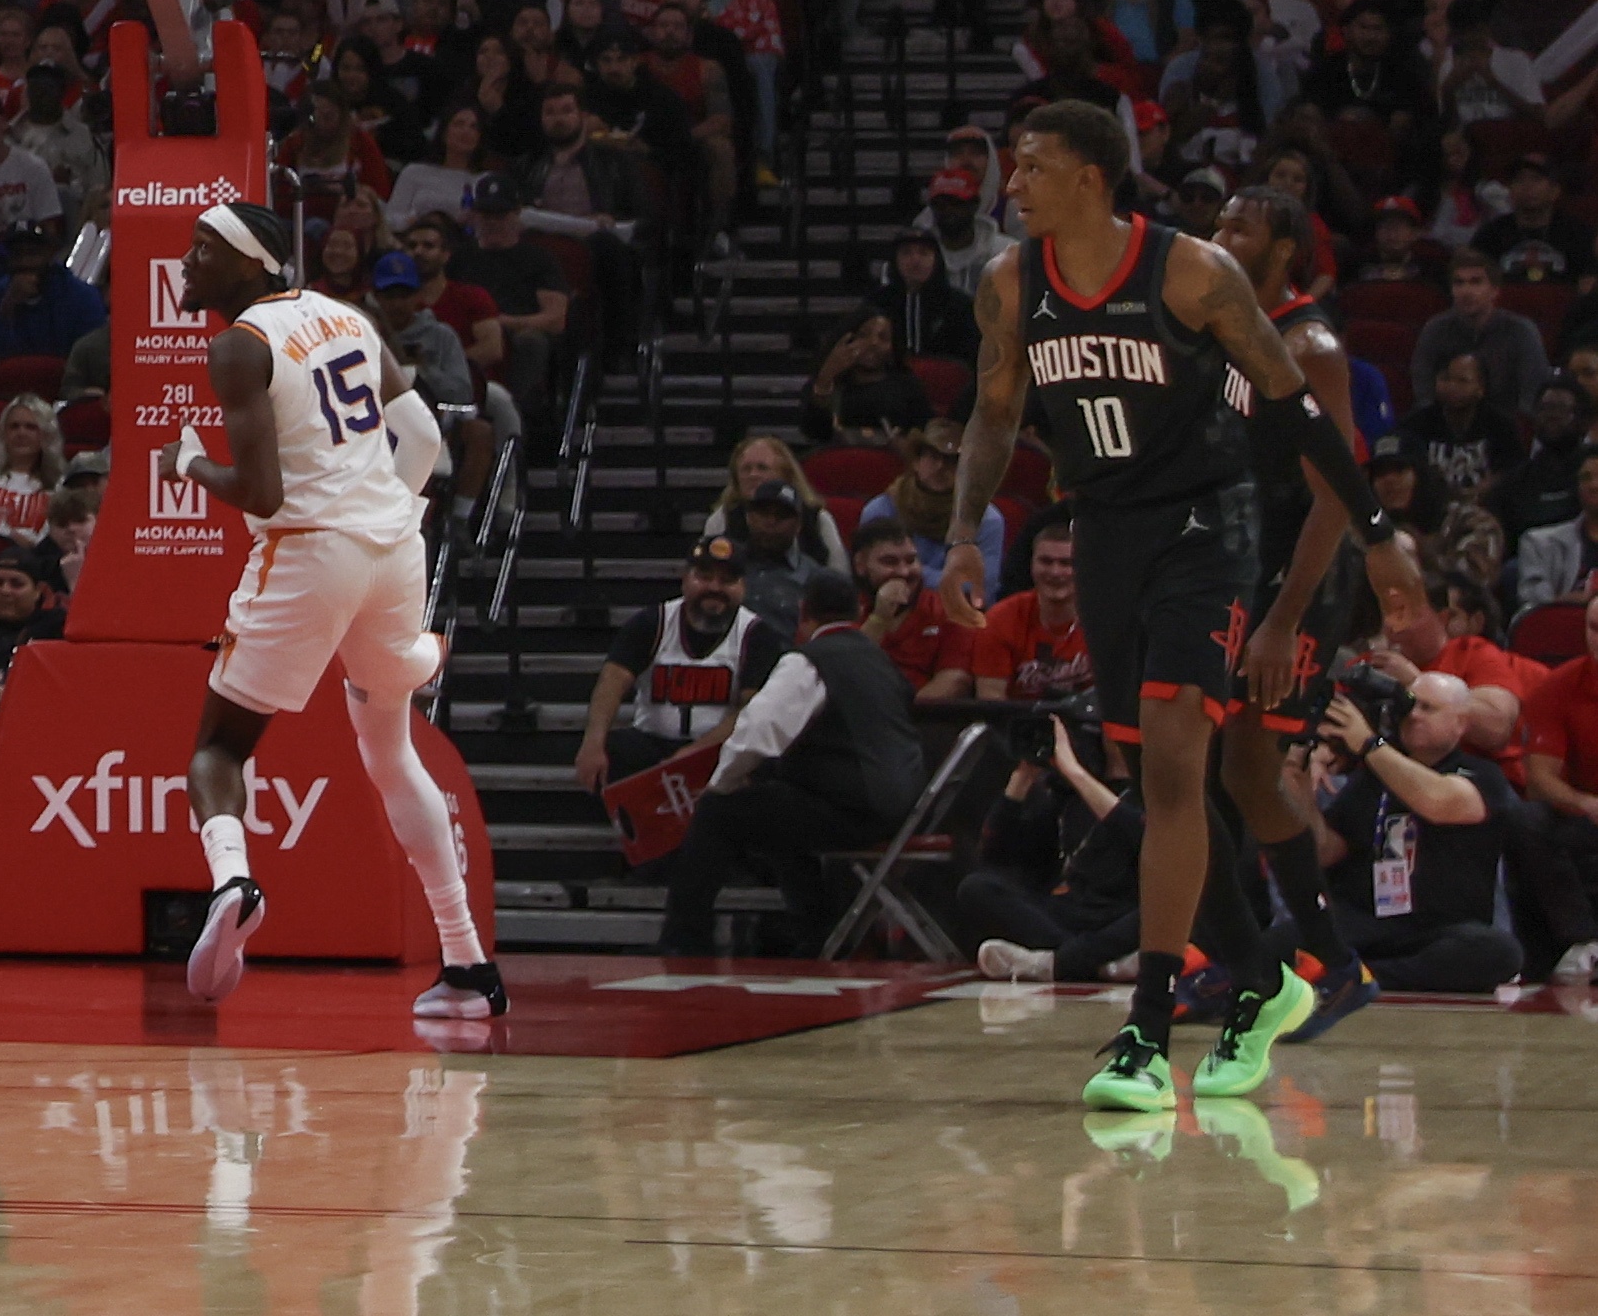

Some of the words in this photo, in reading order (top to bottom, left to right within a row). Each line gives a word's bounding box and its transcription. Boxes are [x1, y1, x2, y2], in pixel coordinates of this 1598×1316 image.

[117, 181, 210, 207] reliant
[135, 334, 212, 350] MOKARA
[281, 314, 363, 366] WILLIAMS
[1026, 334, 1170, 387] HOUSTON
[161, 383, 195, 405] 281
[312, 349, 383, 447] 15
[1075, 395, 1133, 459] 10
[134, 526, 224, 541] MOKARAM
[29, 748, 330, 851] xfinty
